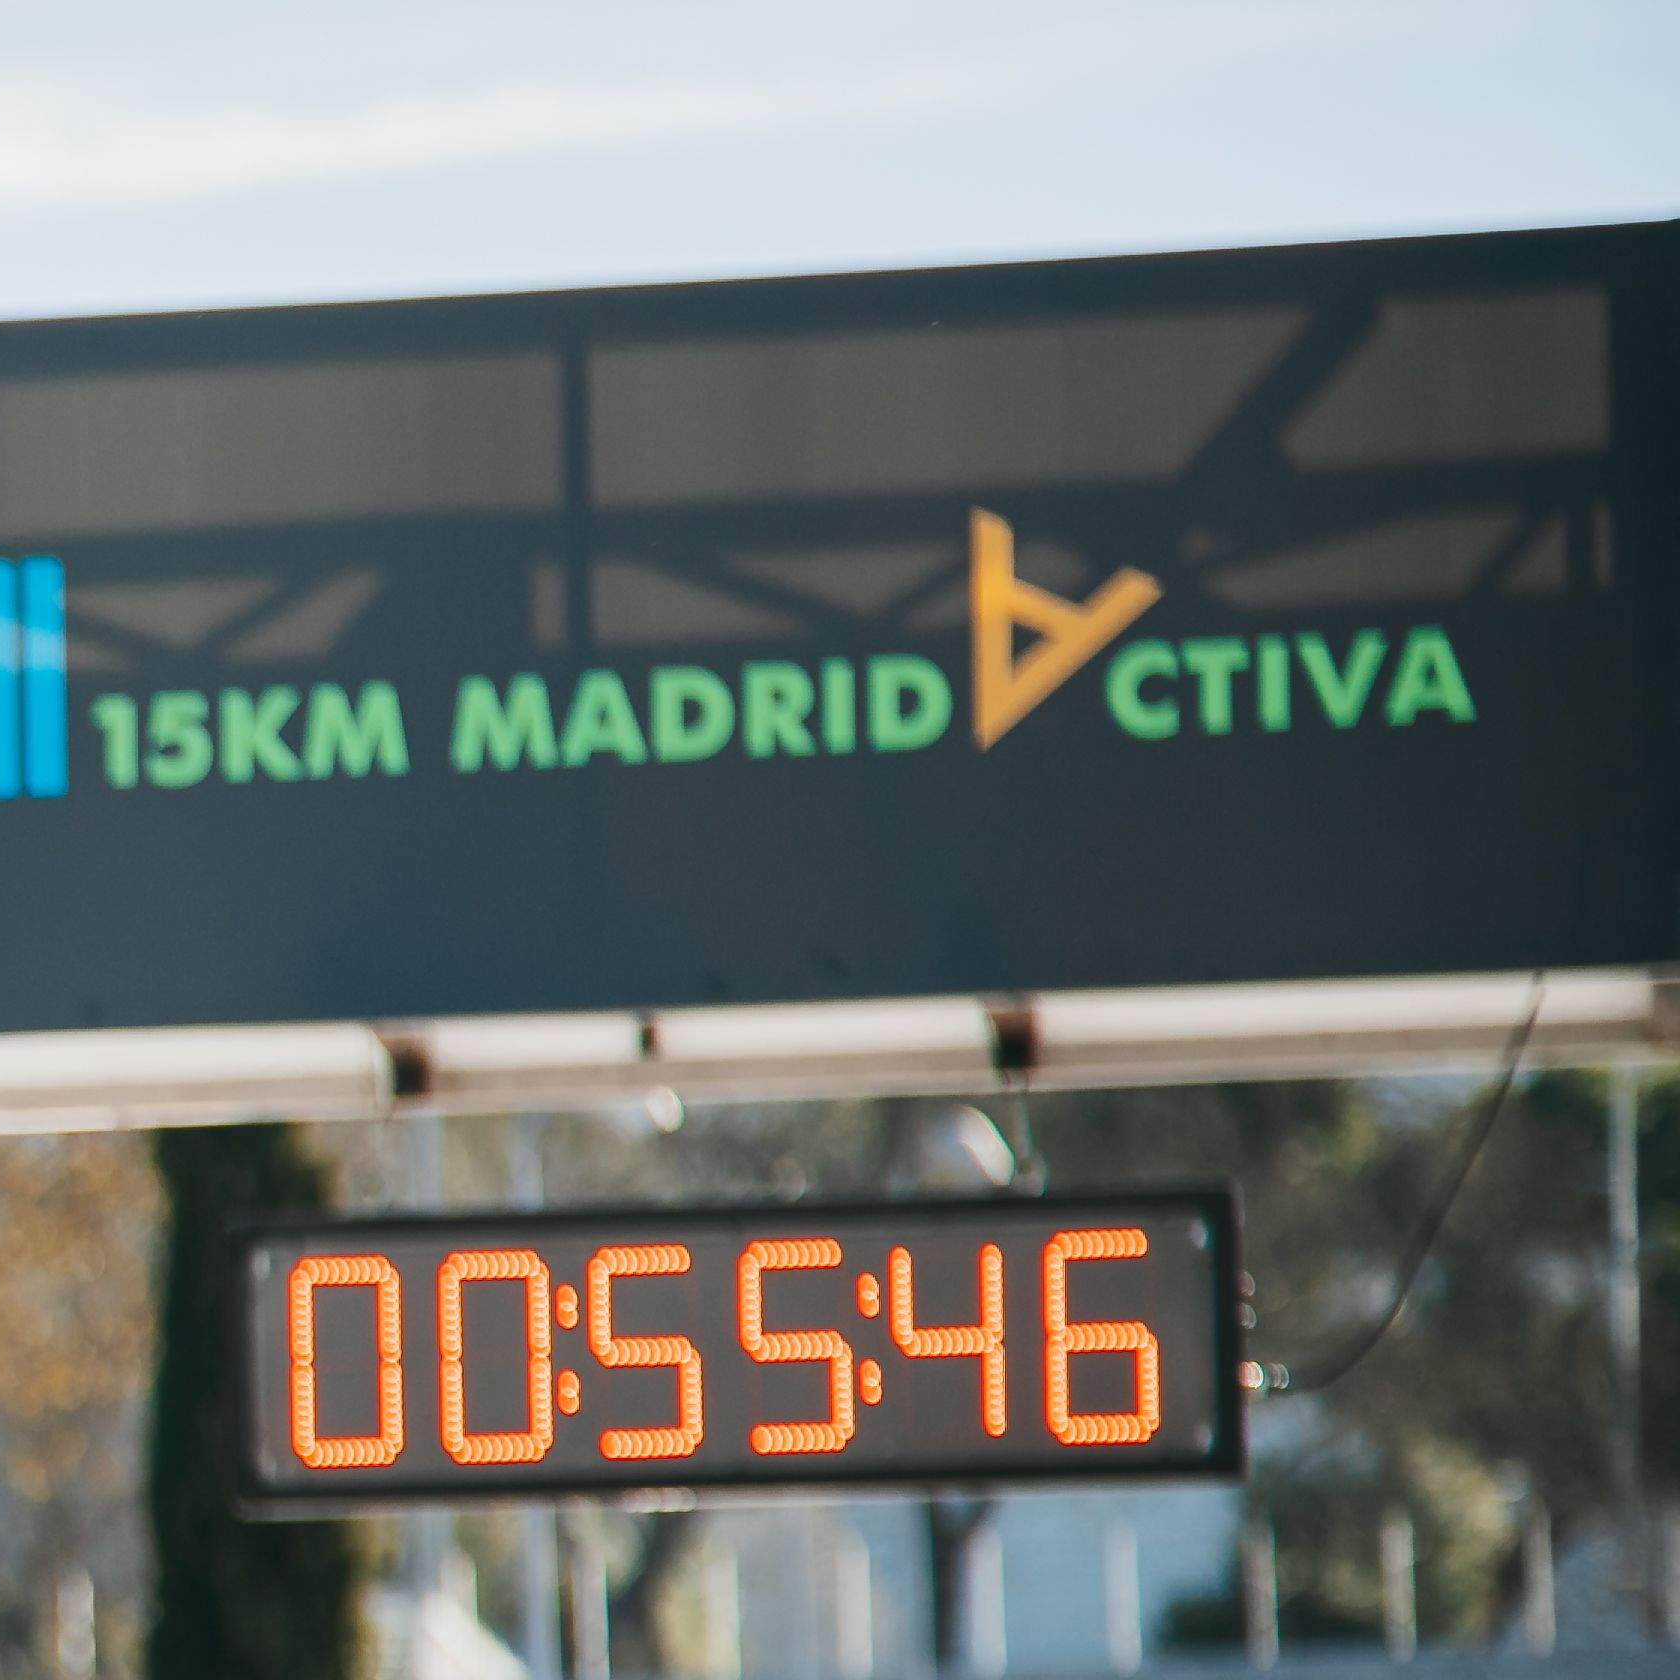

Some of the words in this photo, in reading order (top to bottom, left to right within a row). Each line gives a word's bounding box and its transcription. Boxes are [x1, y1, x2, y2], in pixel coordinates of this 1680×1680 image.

[93, 682, 410, 790] 15KM
[453, 653, 951, 770] MADRID
[289, 1227, 1159, 1469] 00:55:46
